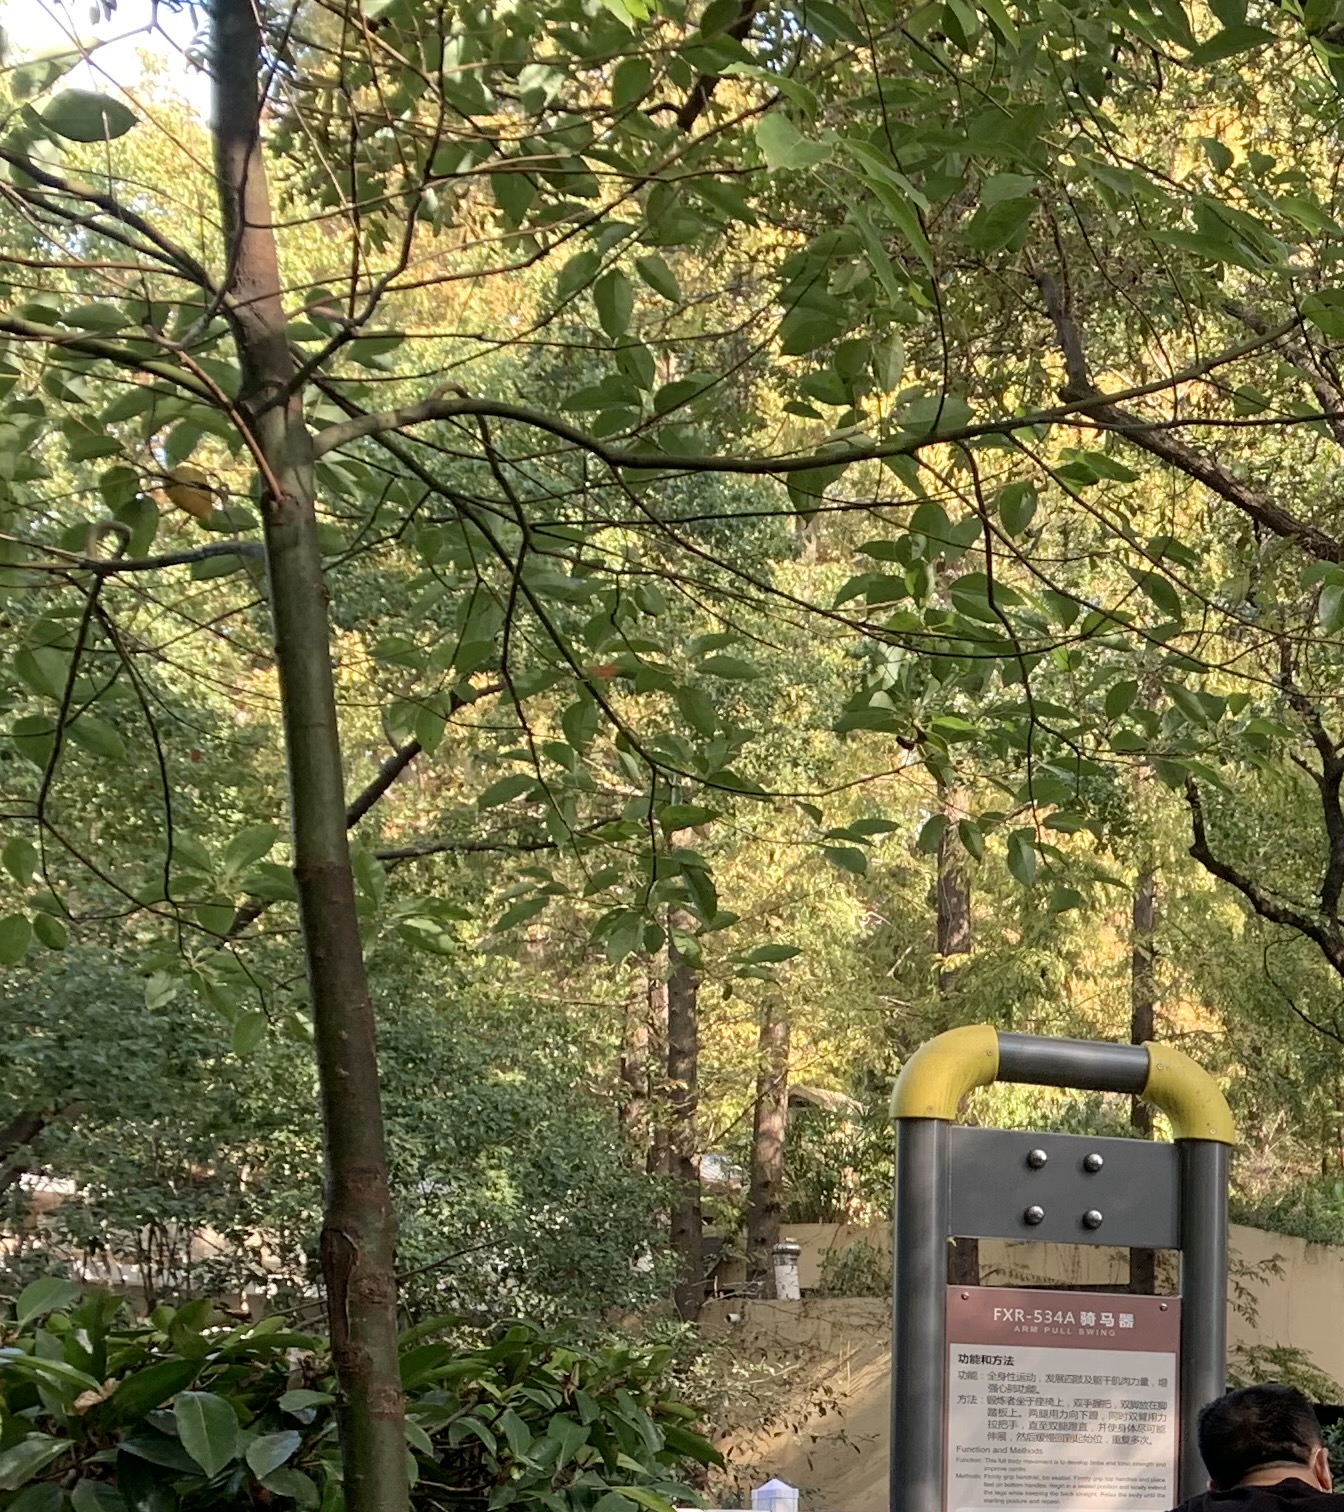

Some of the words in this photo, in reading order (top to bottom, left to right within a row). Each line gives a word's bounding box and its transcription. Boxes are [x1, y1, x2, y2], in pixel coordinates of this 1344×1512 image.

[993, 1307, 1075, 1325] FXR-534A
[1080, 1311, 1134, 1328] 骑马器
[1014, 1325, 1038, 1333] ARM
[1044, 1326, 1072, 1335] PULL
[1078, 1328, 1116, 1337] SWING
[957, 1353, 1015, 1366] 功能和方法
